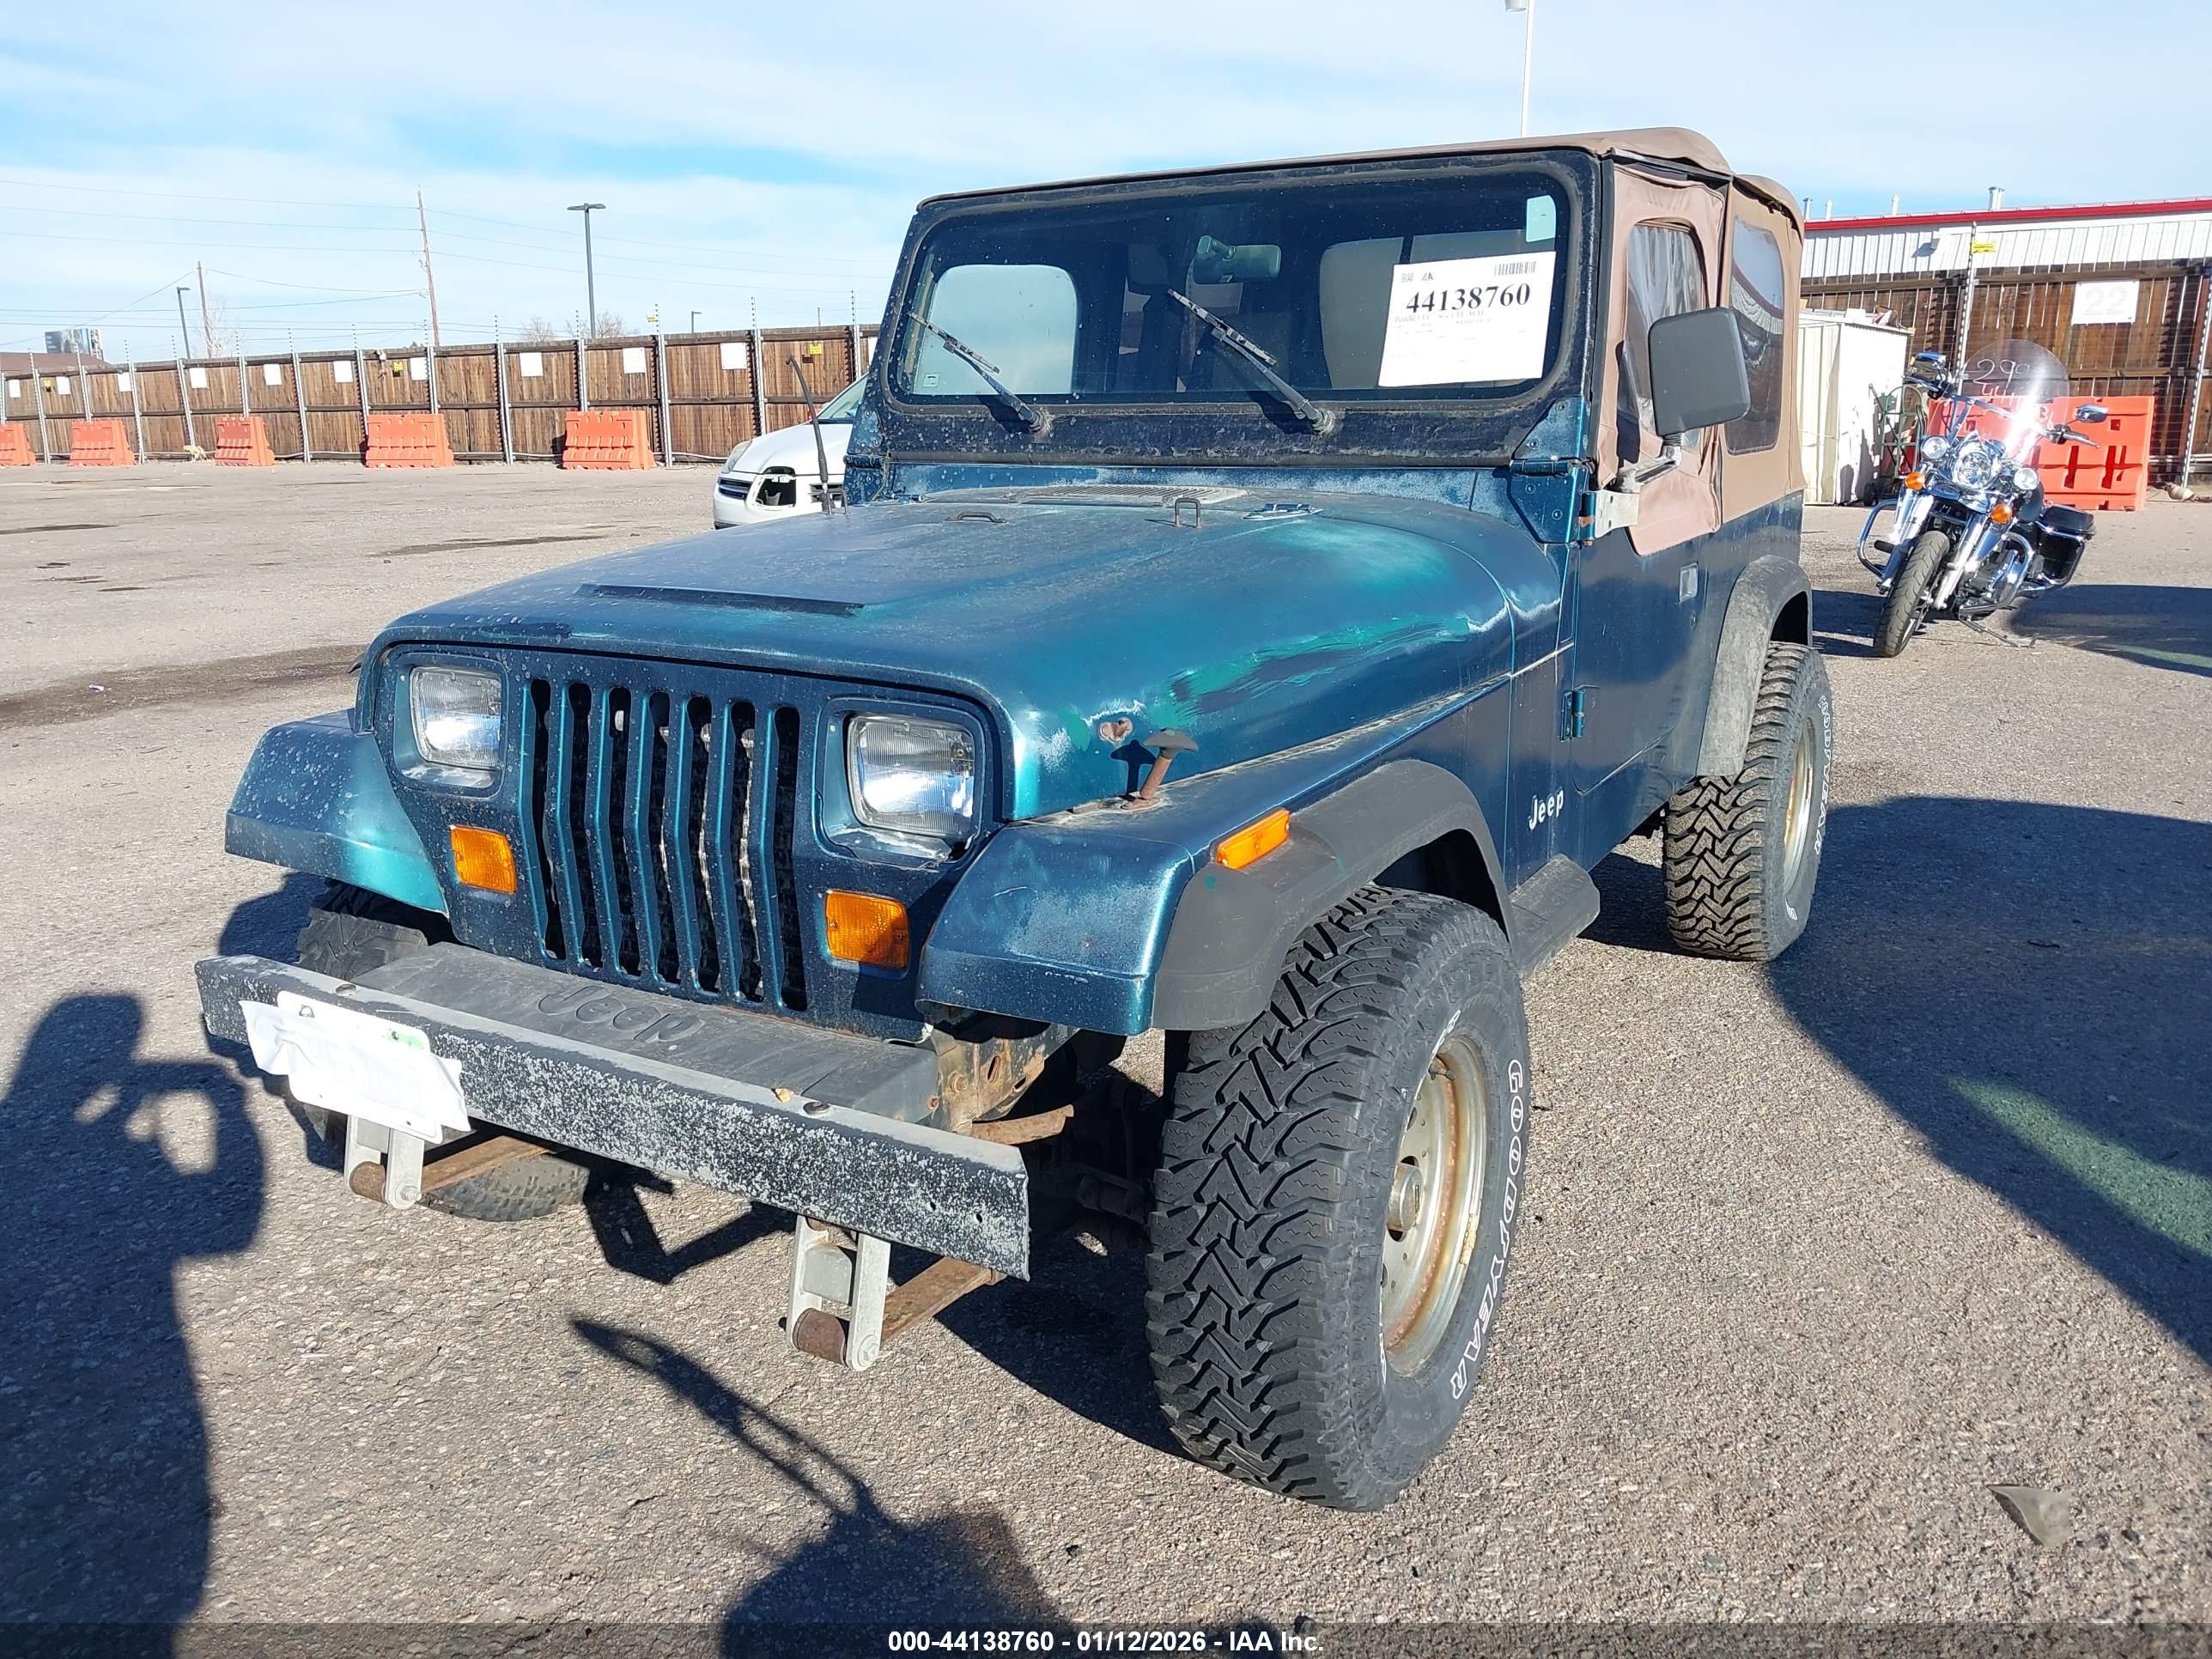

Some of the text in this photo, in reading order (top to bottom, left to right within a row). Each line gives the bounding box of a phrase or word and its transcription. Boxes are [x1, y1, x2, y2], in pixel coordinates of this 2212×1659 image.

[1406, 283, 1531, 313] 44138760
[1814, 695, 1832, 855] GOODYEAR
[1528, 788, 1565, 830] Jeep
[538, 985, 705, 1043] Jeep
[1451, 1059, 1524, 1401] GOODYEAR
